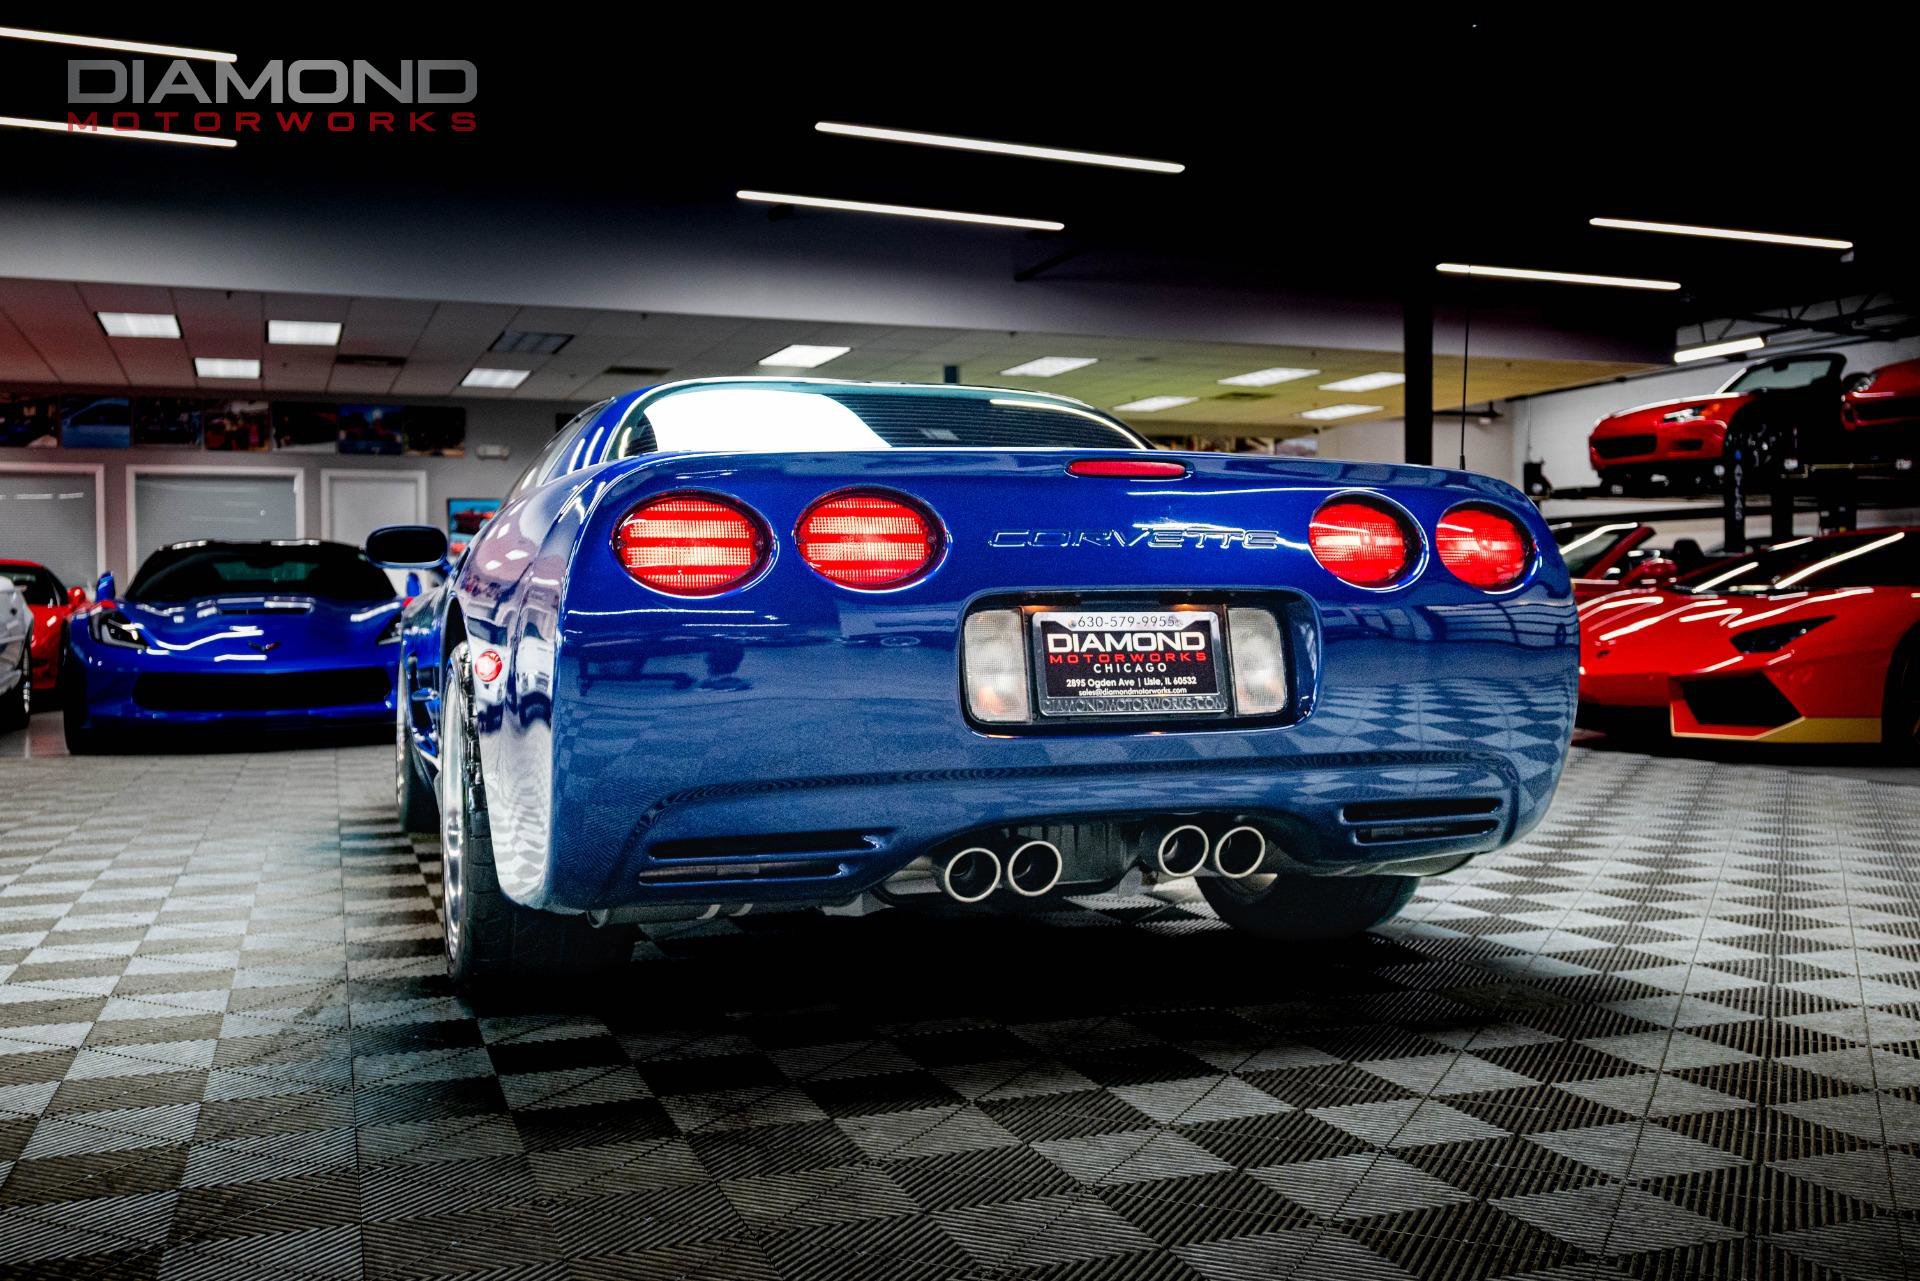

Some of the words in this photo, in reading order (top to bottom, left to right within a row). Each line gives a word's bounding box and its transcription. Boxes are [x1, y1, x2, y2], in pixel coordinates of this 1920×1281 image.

[988, 529, 1278, 549] CORVETTE
[1077, 616, 1175, 628] 630-579-9955
[1047, 632, 1205, 653] DIAMOND
[1050, 652, 1207, 664] MOTORWORKS
[1093, 663, 1167, 673] CHICAGO
[1066, 678, 1086, 687] 2895
[1087, 678, 1117, 688] Ogden
[1118, 678, 1135, 686] Ave
[1143, 677, 1163, 686] Lisle,
[1164, 677, 1172, 685] IL
[1173, 676, 1197, 685] 60532
[1079, 687, 1187, 696] sales@diamondmotorworks.com
